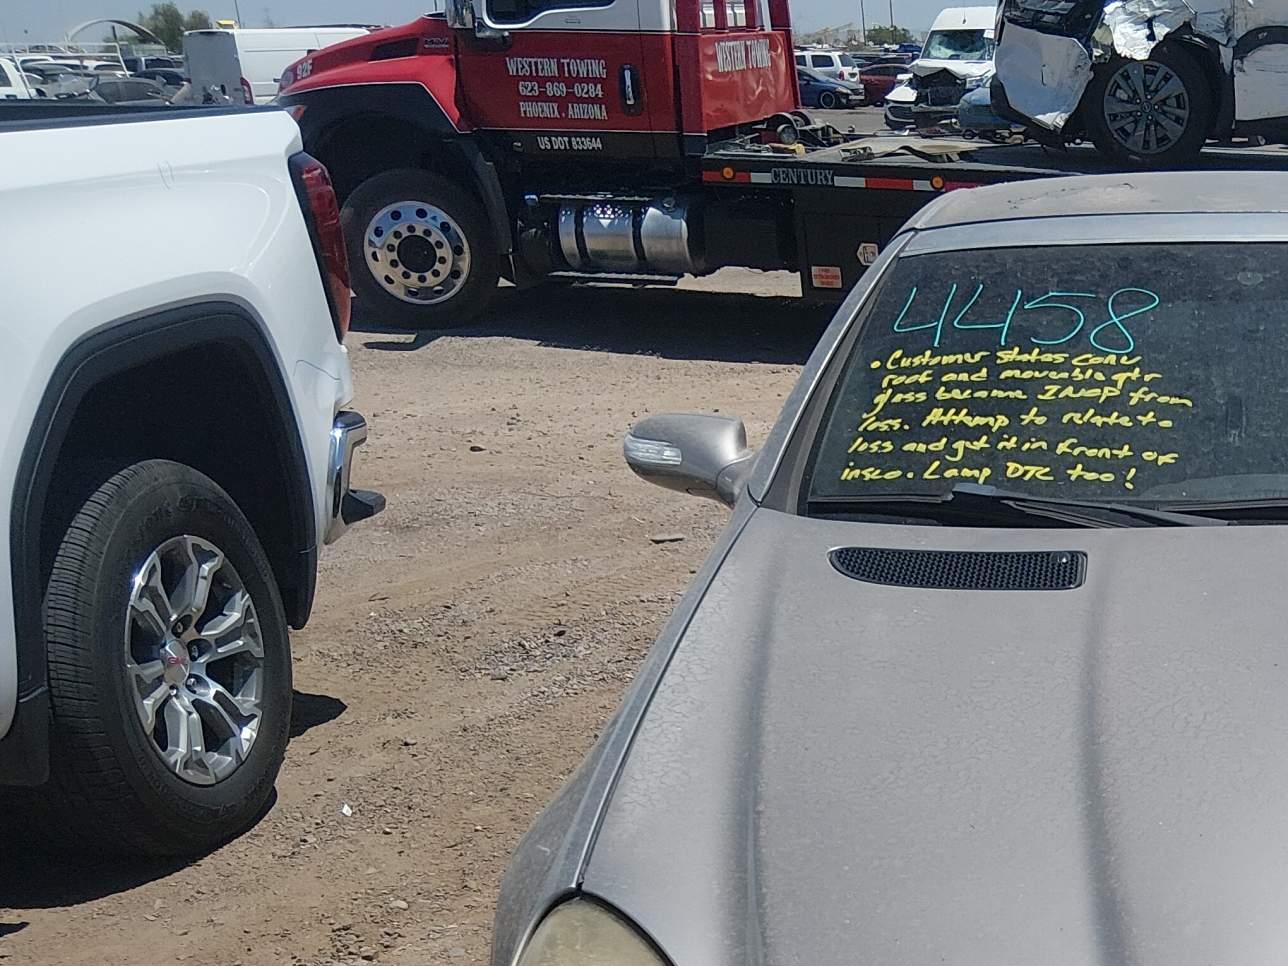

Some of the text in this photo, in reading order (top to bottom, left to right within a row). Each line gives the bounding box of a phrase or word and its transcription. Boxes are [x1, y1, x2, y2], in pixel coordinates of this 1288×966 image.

[505, 57, 607, 78] WESTERN TOWING
[519, 81, 604, 98] 623-869-0284
[519, 101, 608, 120] PHOENIX ARIZONA
[537, 136, 551, 150] US
[551, 136, 570, 150] DOT
[770, 167, 834, 185] CENTURY
[893, 283, 1160, 354] 4458
[886, 349, 991, 370] Customer
[941, 367, 988, 382] and
[1128, 386, 1193, 408] from
[1020, 407, 1048, 426] to
[1136, 411, 1173, 428] to
[847, 436, 894, 454] loss
[901, 437, 948, 454] and
[996, 433, 1018, 450] it
[1021, 437, 1048, 452] in
[1055, 438, 1134, 459] front
[1141, 450, 1179, 467] of
[922, 460, 992, 485] Lamp
[1005, 461, 1055, 481] DTC
